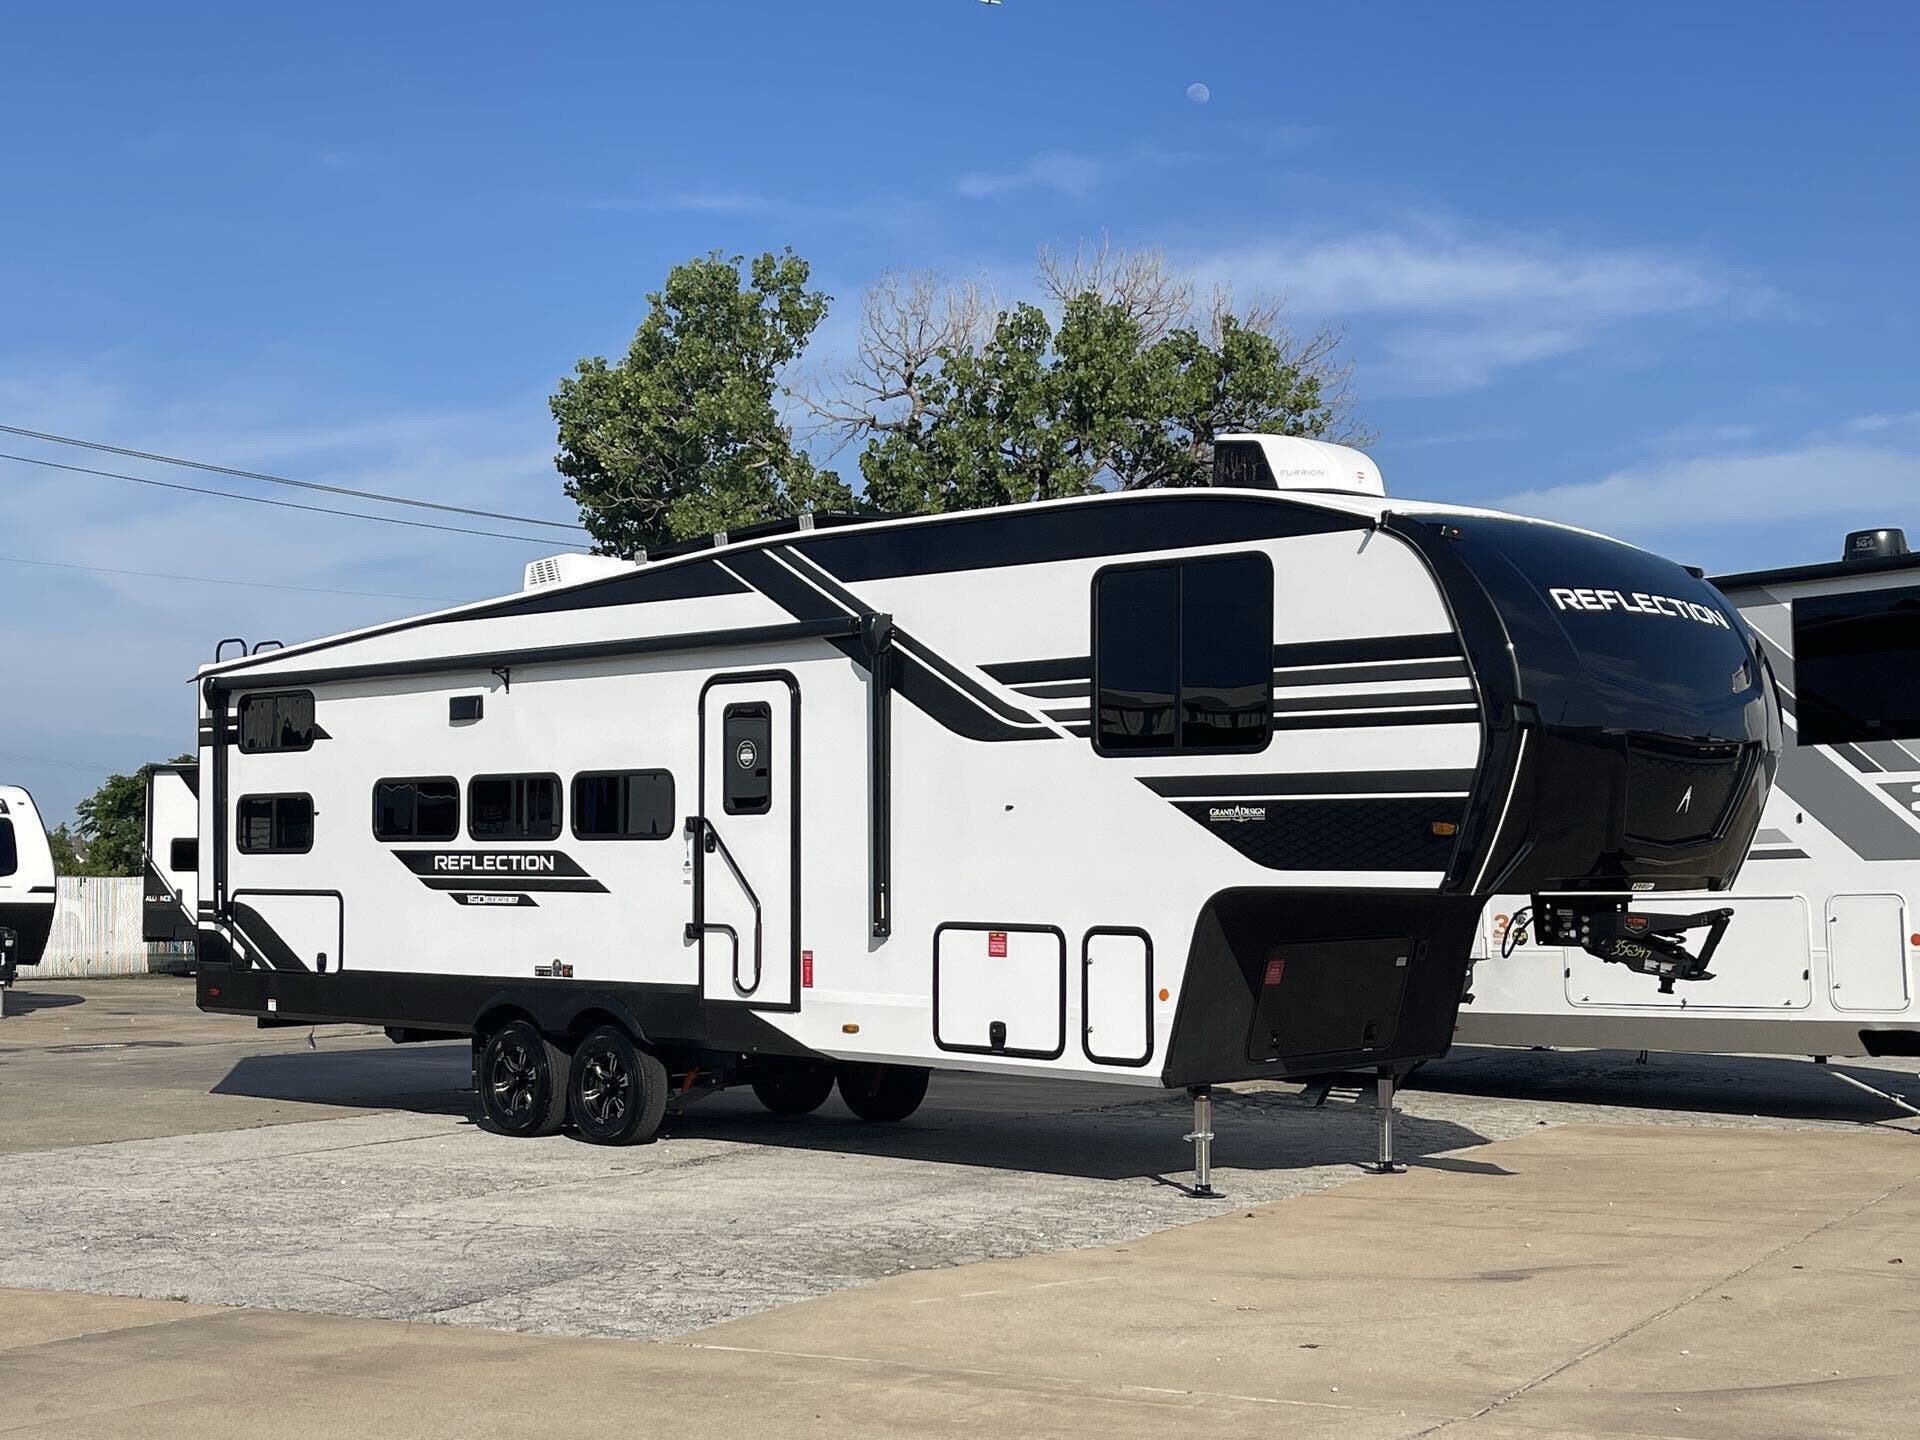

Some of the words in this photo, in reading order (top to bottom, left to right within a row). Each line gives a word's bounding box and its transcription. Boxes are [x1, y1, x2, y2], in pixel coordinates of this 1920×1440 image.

[1279, 469, 1326, 477] FURRION
[1548, 588, 1731, 630] REFLECTION
[1209, 807, 1235, 816] GRAND
[1240, 807, 1266, 816] DESIGN
[434, 855, 555, 871] REFLECTION
